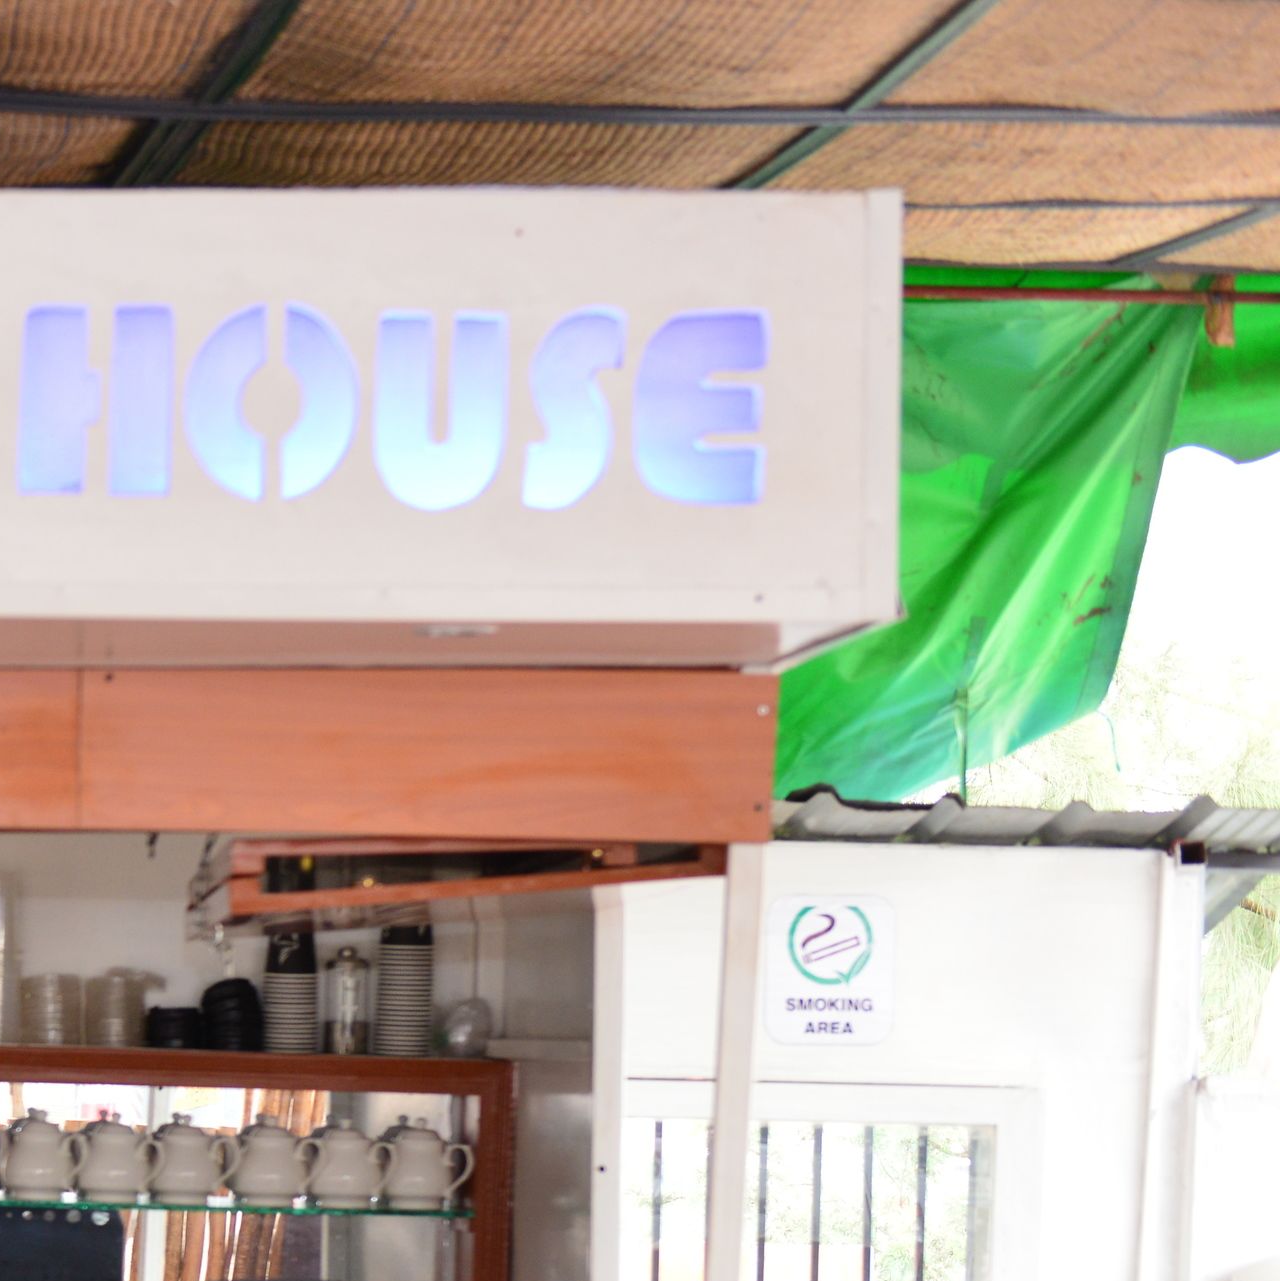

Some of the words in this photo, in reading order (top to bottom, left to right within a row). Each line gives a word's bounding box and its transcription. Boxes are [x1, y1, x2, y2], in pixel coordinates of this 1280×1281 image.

[16, 302, 770, 511] HOUSE
[786, 998, 873, 1012] SMOKING
[804, 1021, 853, 1034] AREA
